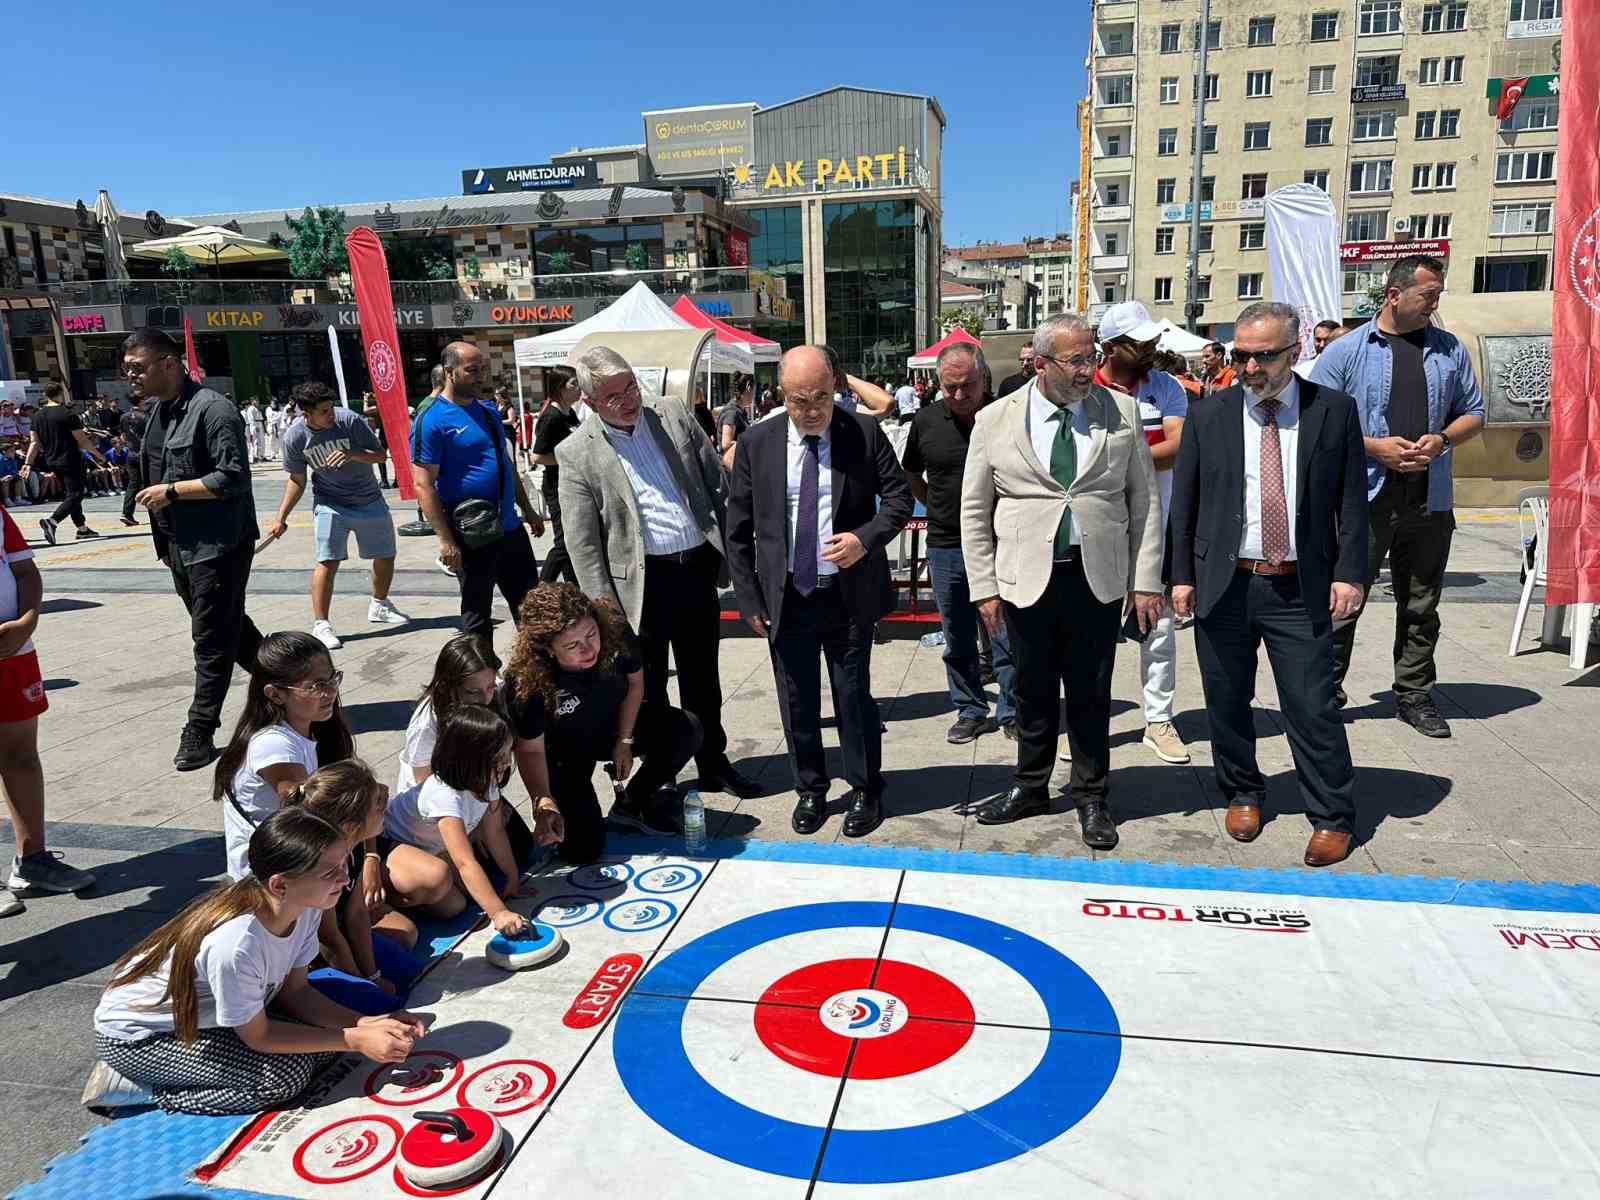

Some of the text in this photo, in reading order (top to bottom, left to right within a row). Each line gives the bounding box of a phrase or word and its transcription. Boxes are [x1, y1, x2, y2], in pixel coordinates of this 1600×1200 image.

[764, 160, 806, 189] AK
[817, 145, 906, 184] PARTİ
[63, 314, 104, 330] CAFE
[207, 308, 264, 326] KİTAP
[491, 304, 574, 322] OYUNCAK
[575, 963, 633, 1019] START
